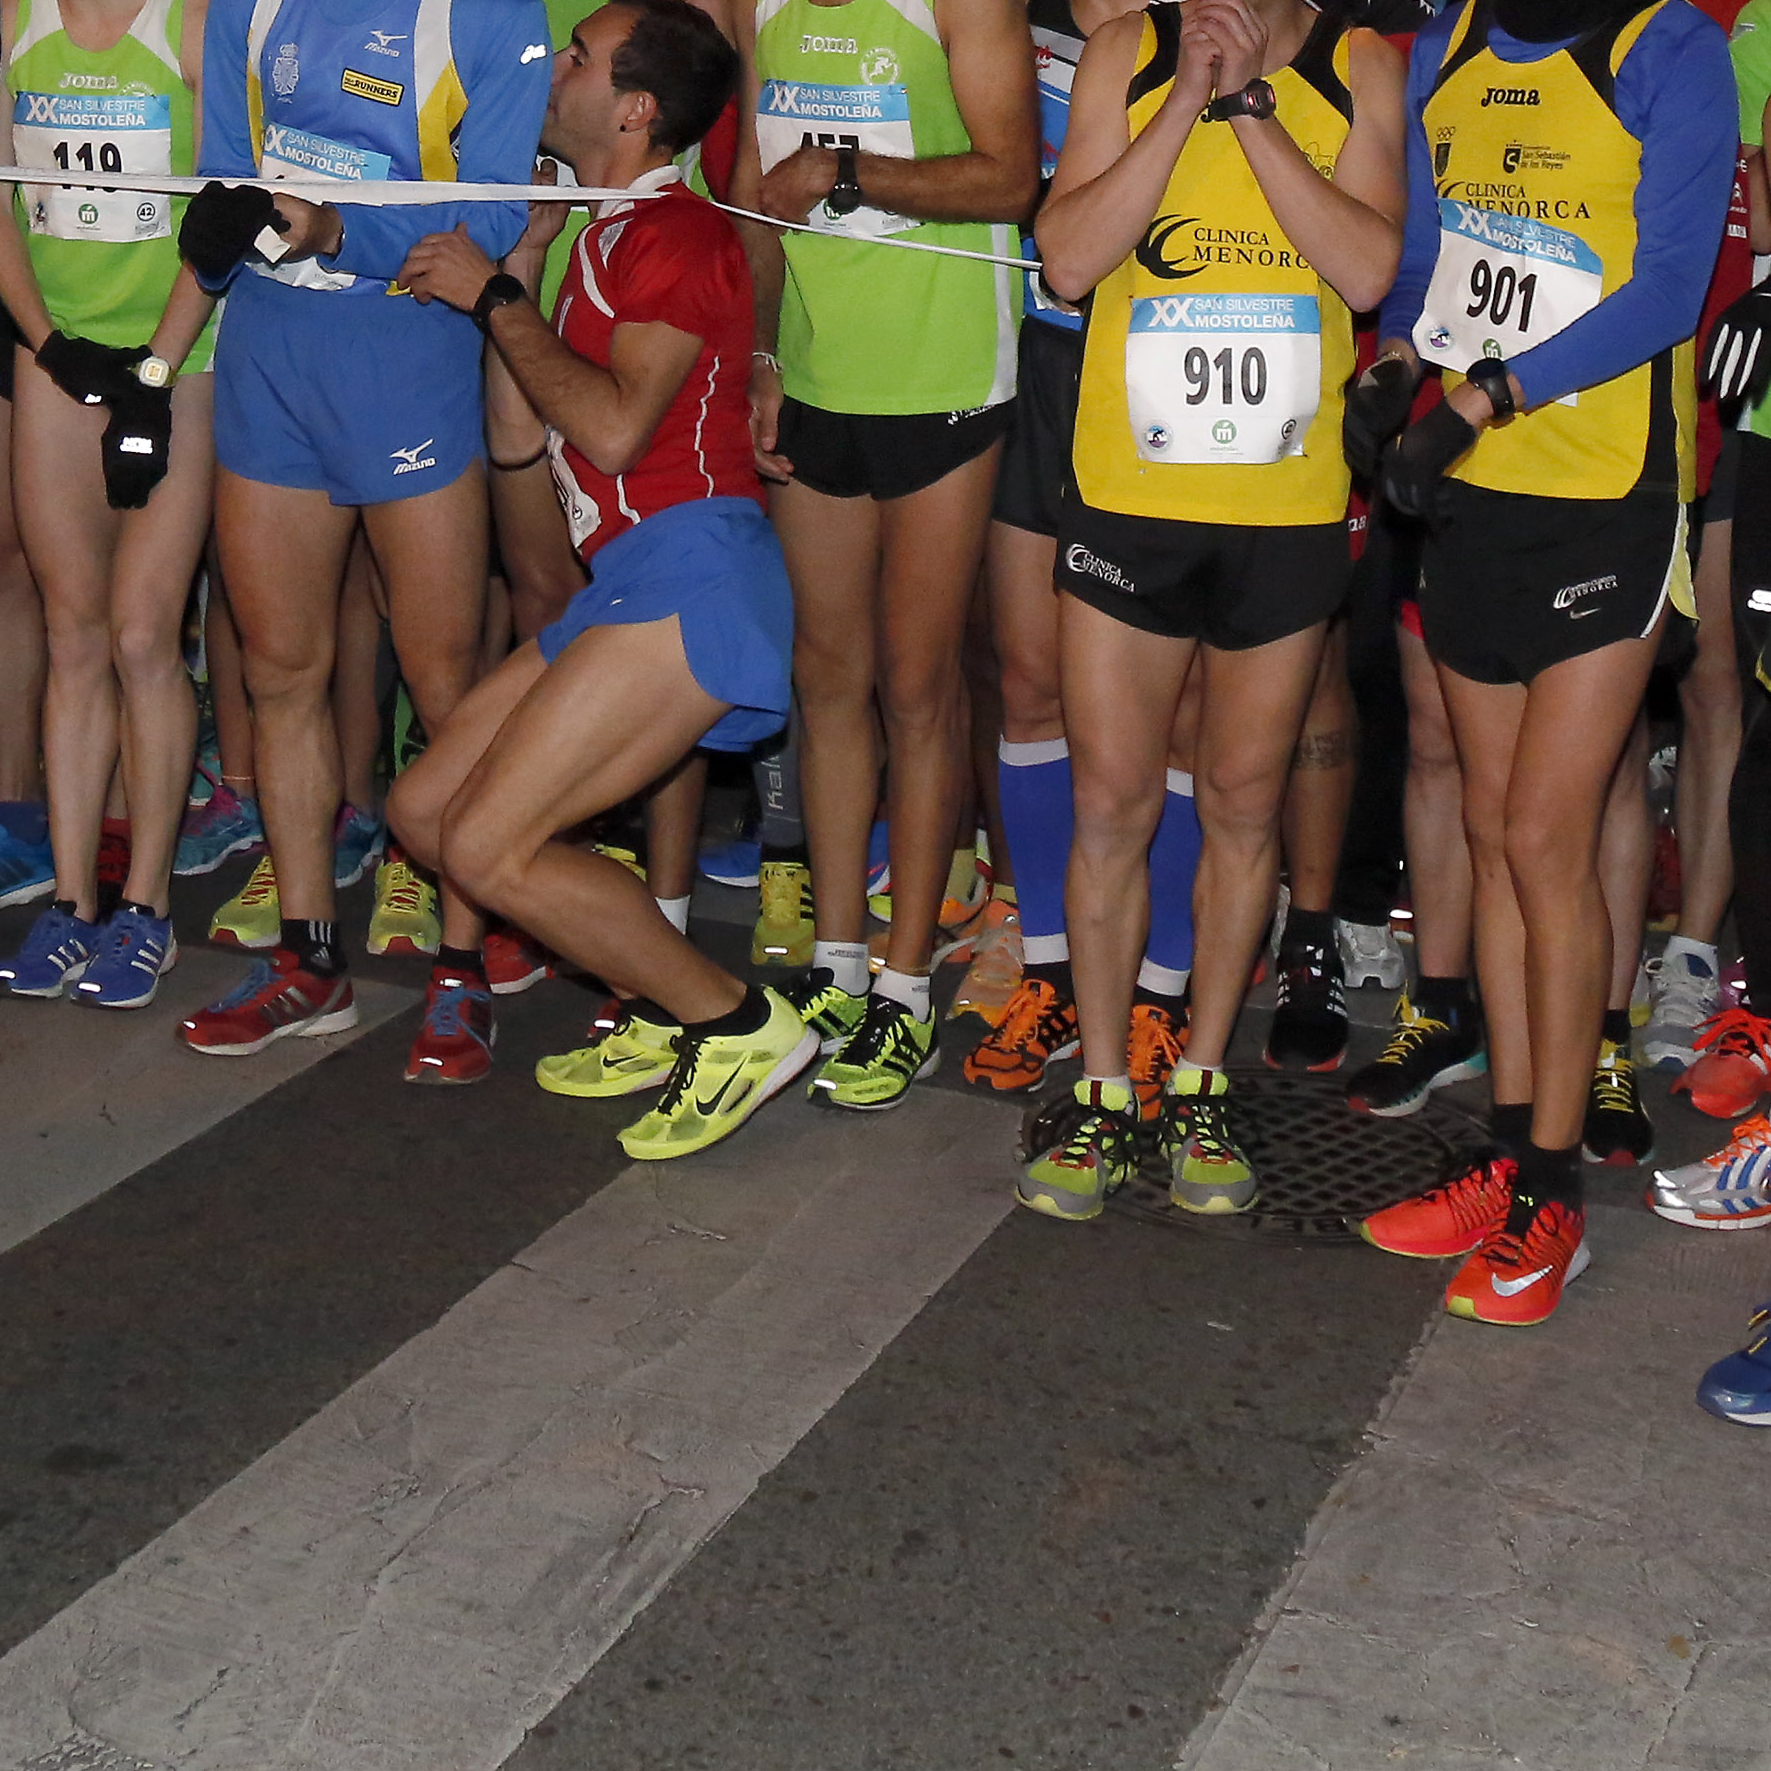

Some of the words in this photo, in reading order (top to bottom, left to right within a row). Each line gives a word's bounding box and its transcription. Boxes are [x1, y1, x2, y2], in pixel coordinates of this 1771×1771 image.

[354, 79, 398, 98] RUNNERS
[769, 85, 801, 114] XX
[800, 88, 820, 99] SAN
[822, 89, 880, 102] SILVESTRE
[26, 95, 59, 124] XX
[59, 99, 81, 110] SAN
[85, 100, 145, 111] SILVESTRE
[800, 102, 882, 117] MOSTOLEÑA
[59, 113, 146, 126] MOSTOLEÑA
[287, 133, 309, 147] SAN
[311, 140, 366, 164] SILVESTRE
[53, 142, 122, 193] 119
[285, 146, 362, 180] MOSTOLEÑA
[1466, 183, 1526, 198] CLINICA
[140, 207, 152, 216] 42
[1455, 203, 1492, 240] XX
[1194, 228, 1269, 245] CLINICA
[1492, 229, 1577, 263] MOSTOLEÑA
[1517, 221, 1576, 248] SILVESTRE
[1192, 246, 1310, 269] MENORC
[1194, 298, 1223, 310] SAN
[1225, 299, 1294, 311] SILVESTRE
[1466, 259, 1538, 333] 901
[1148, 298, 1195, 327] XX
[1195, 312, 1295, 328] MOSTOLEÑA
[1184, 346, 1267, 406] 910
[1081, 560, 1135, 592] MENORCA
[1083, 553, 1122, 577] CLINICA
